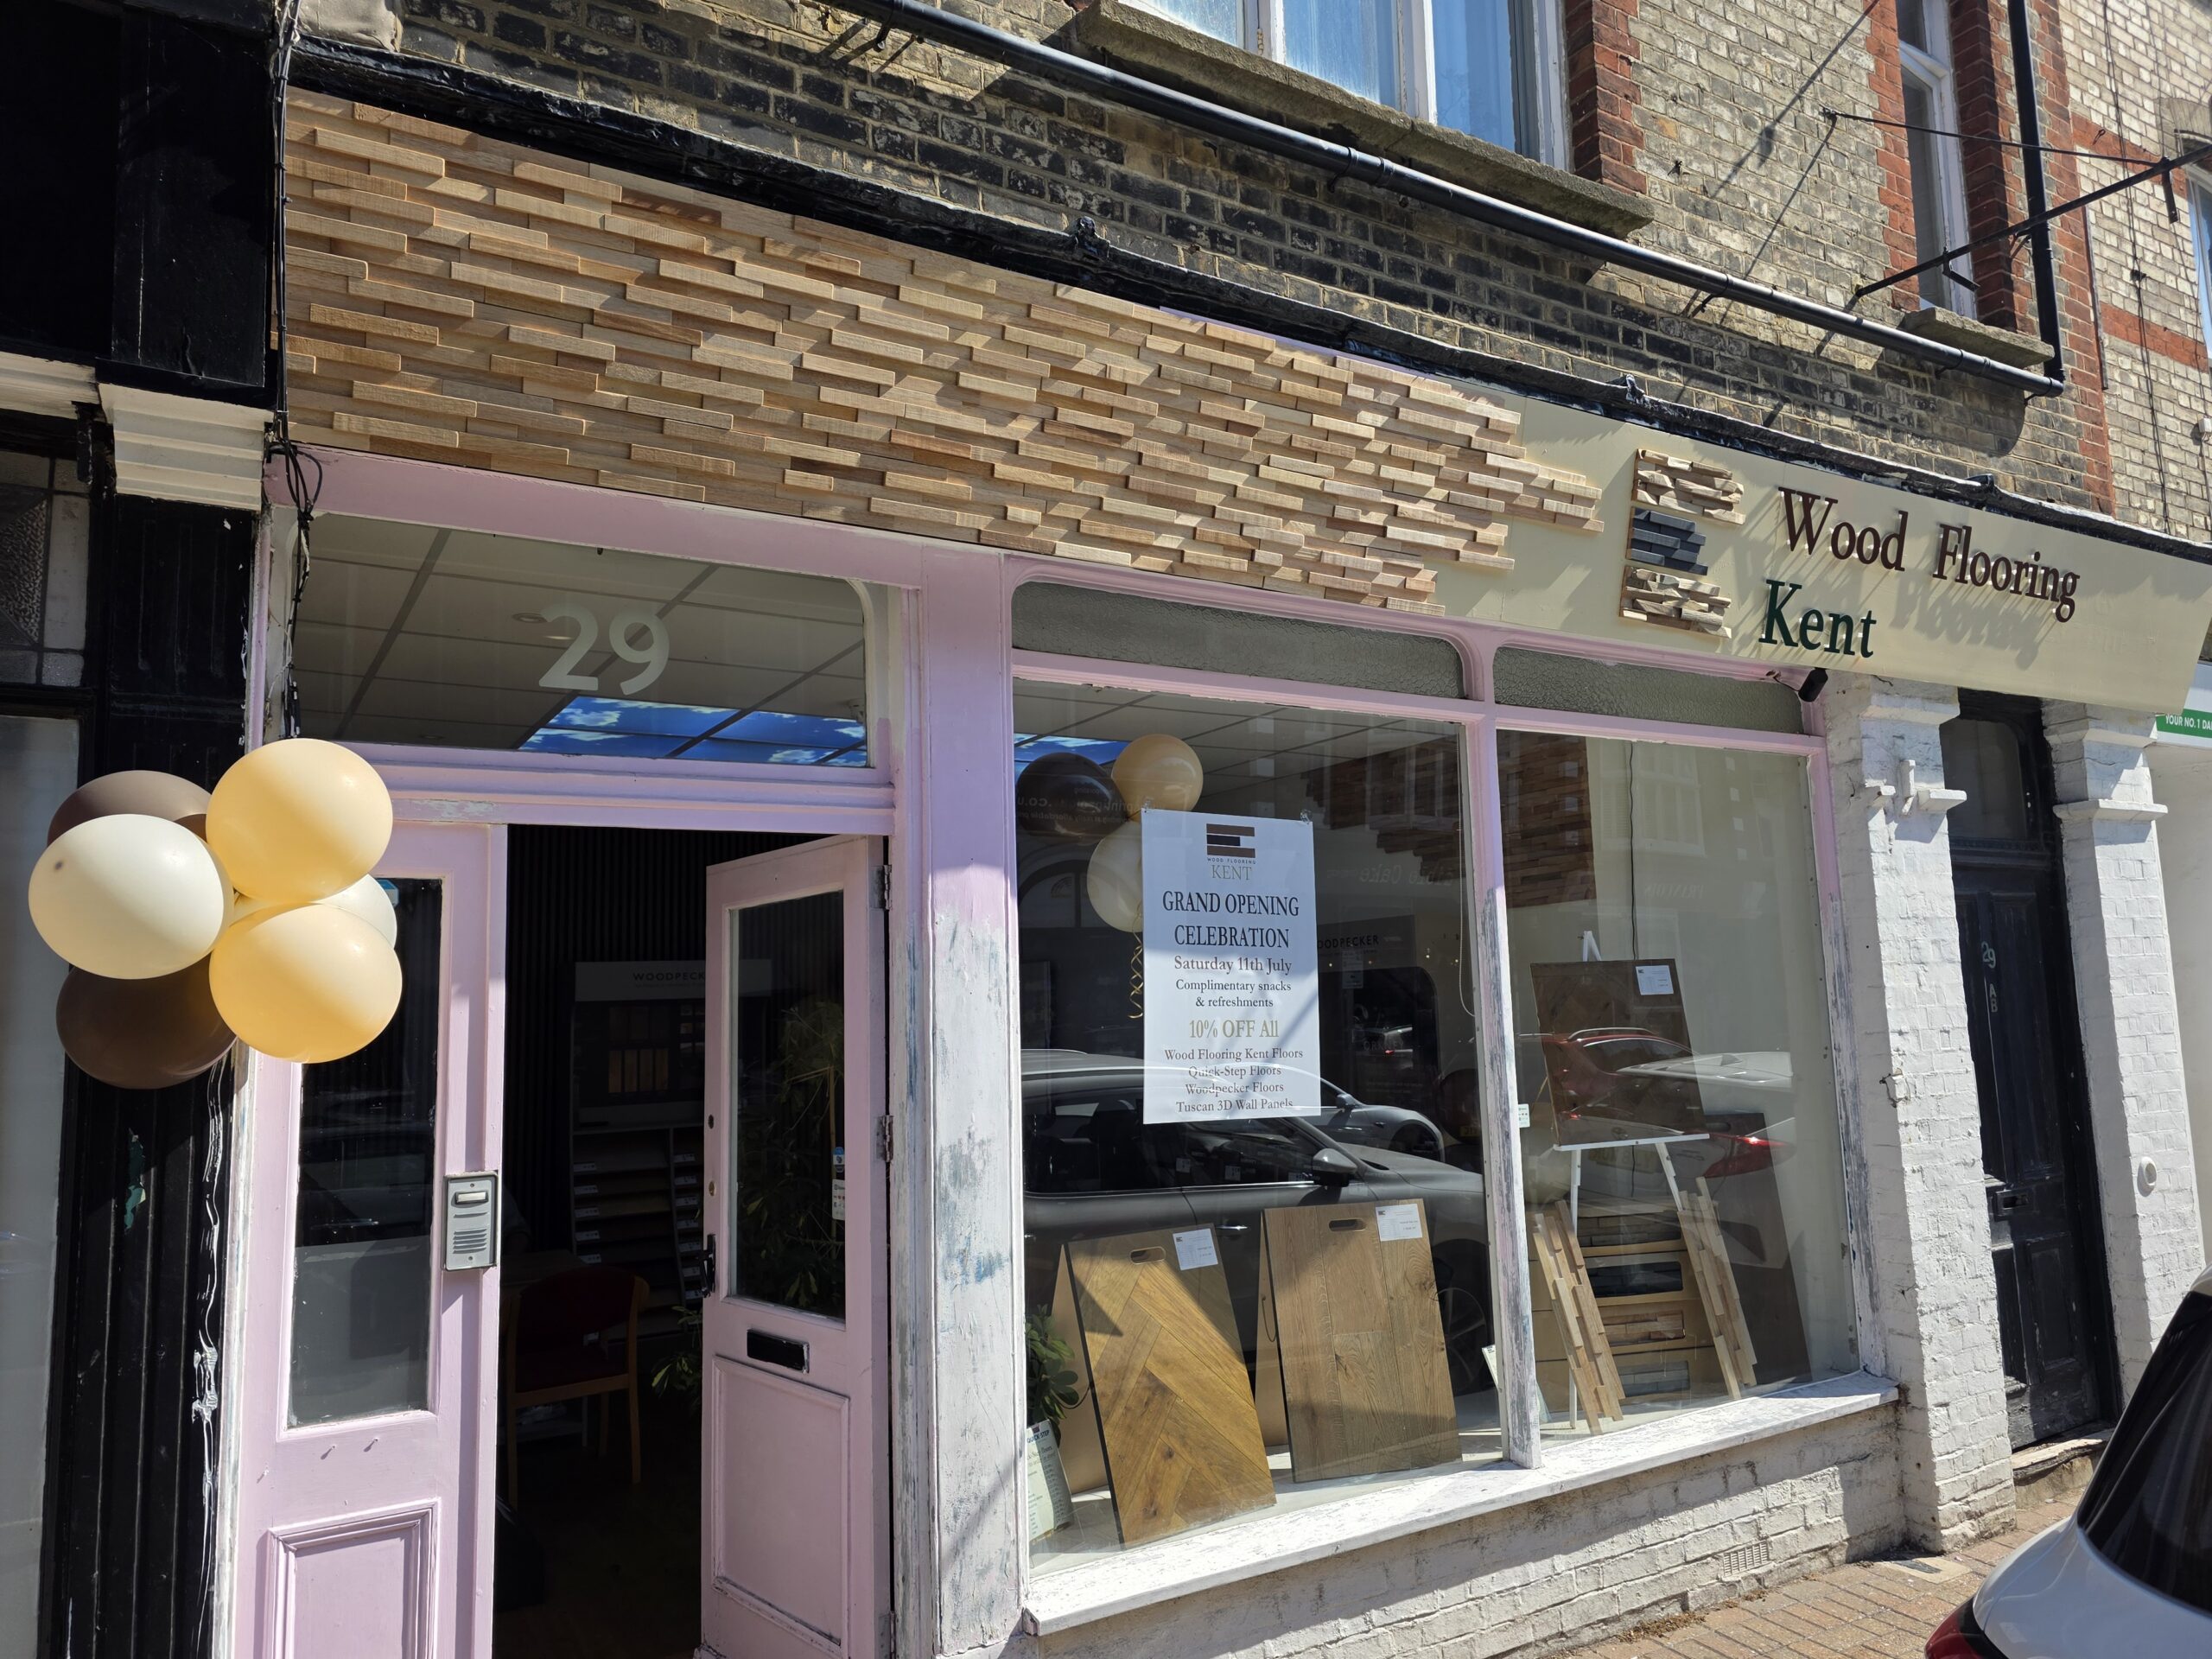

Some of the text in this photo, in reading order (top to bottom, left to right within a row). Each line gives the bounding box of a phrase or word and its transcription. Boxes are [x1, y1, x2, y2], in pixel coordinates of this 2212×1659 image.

[1778, 486, 2081, 623] Wood Flooring
[1758, 578, 1877, 658] Kent
[538, 603, 670, 696] 29
[2165, 715, 2183, 726] YOUR
[1211, 865, 1252, 880] KENT
[1162, 890, 1300, 916] GRAND OPENING
[1174, 925, 1289, 949] CELEBRATION
[1318, 934, 1380, 950] OODPECKER
[1981, 940, 1996, 969] 29
[1174, 955, 1293, 976] Saturday 11th July
[632, 972, 705, 982] WOODPECK
[1176, 979, 1292, 994] Complimentary snacks
[1195, 996, 1274, 1007] & refreshments
[1189, 1020, 1279, 1039] 10% OFF All
[1164, 1047, 1304, 1063] Wood Flooring Kent Floors
[1188, 1065, 1281, 1079] Quick-Step Floors
[1185, 1082, 1284, 1097] Woodpecker Floors
[1176, 1098, 1294, 1113] Tuscan 3D Wall Panels
